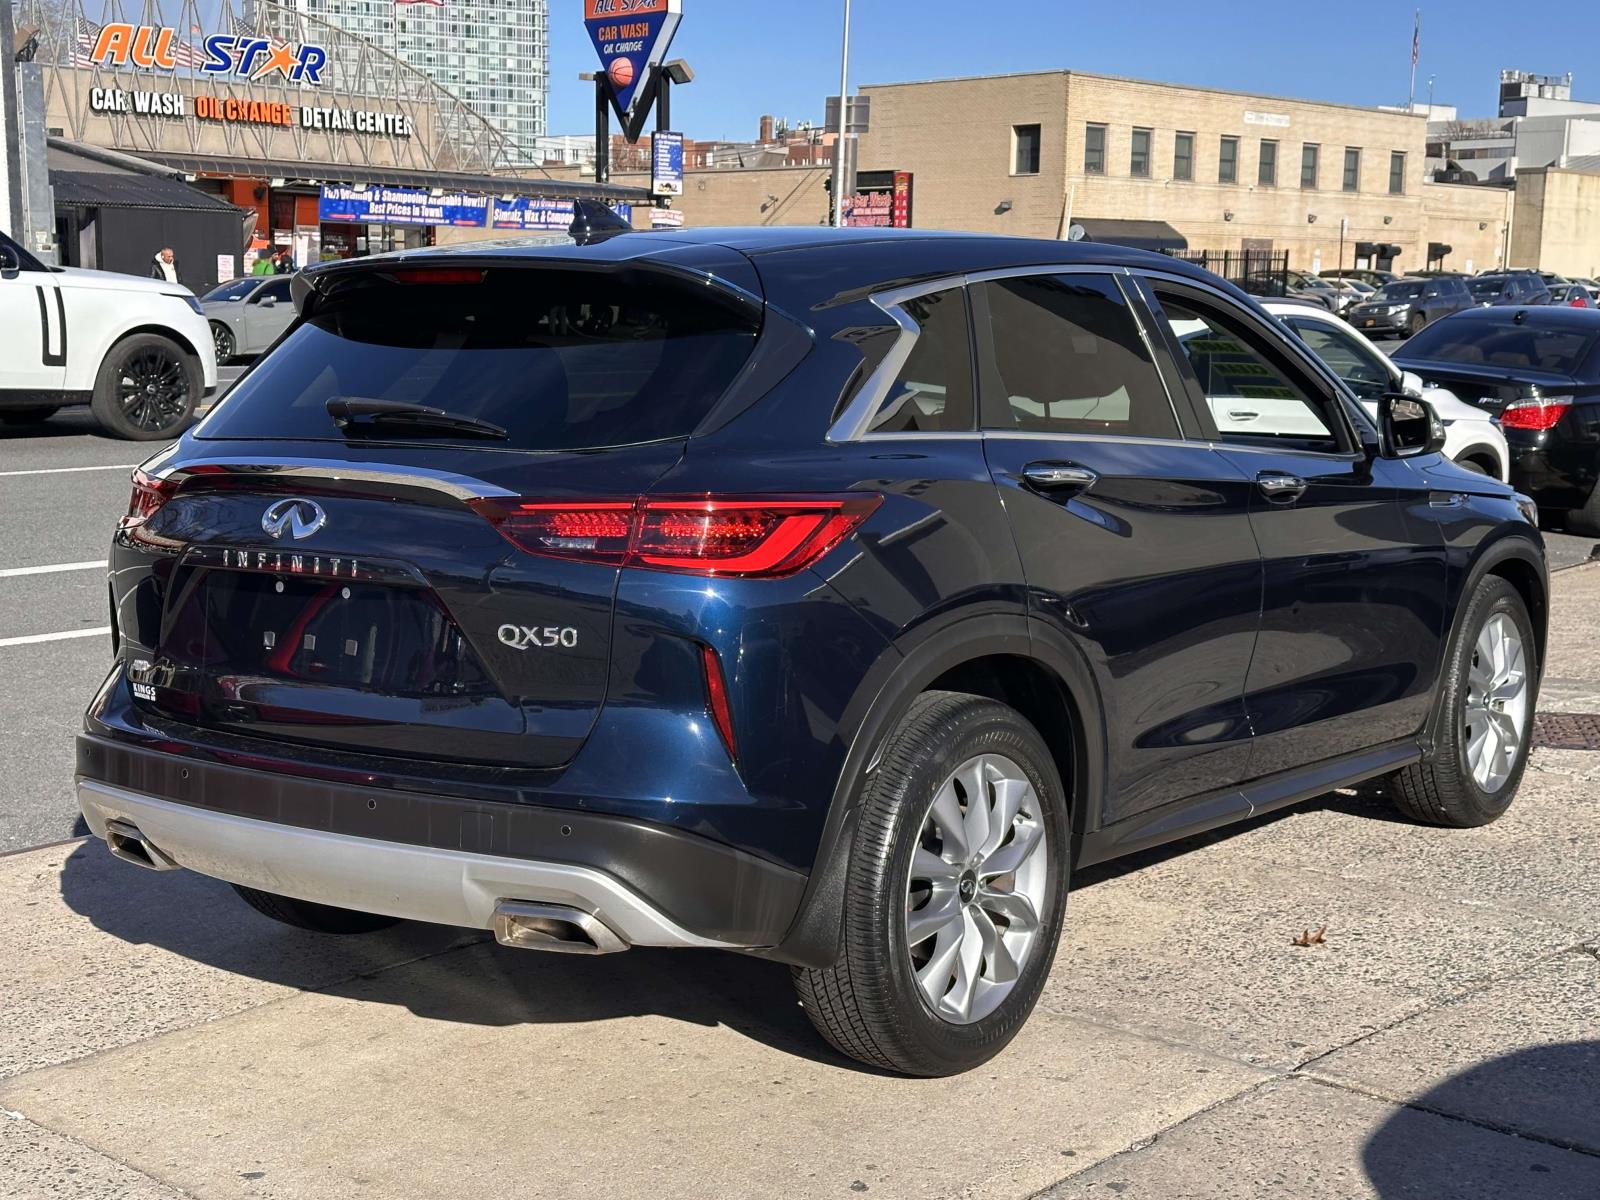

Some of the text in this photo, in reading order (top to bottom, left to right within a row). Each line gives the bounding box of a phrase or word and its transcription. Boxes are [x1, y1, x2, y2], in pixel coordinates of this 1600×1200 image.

[598, 22, 649, 41] CAR WASH
[91, 23, 176, 69] ALL
[603, 41, 643, 54] OIL CHANGE
[91, 88, 127, 111] CAR
[133, 91, 184, 115] WASH
[197, 96, 224, 119] OIL
[225, 98, 292, 126] CHANGE
[356, 111, 413, 135] CENTER
[369, 202, 386, 214] Best
[386, 203, 411, 216] Prices
[524, 209, 539, 222] Wax
[540, 210, 546, 222] &
[222, 549, 358, 578] INFINITI
[497, 624, 578, 650] QX50
[132, 682, 156, 696] KINGS
